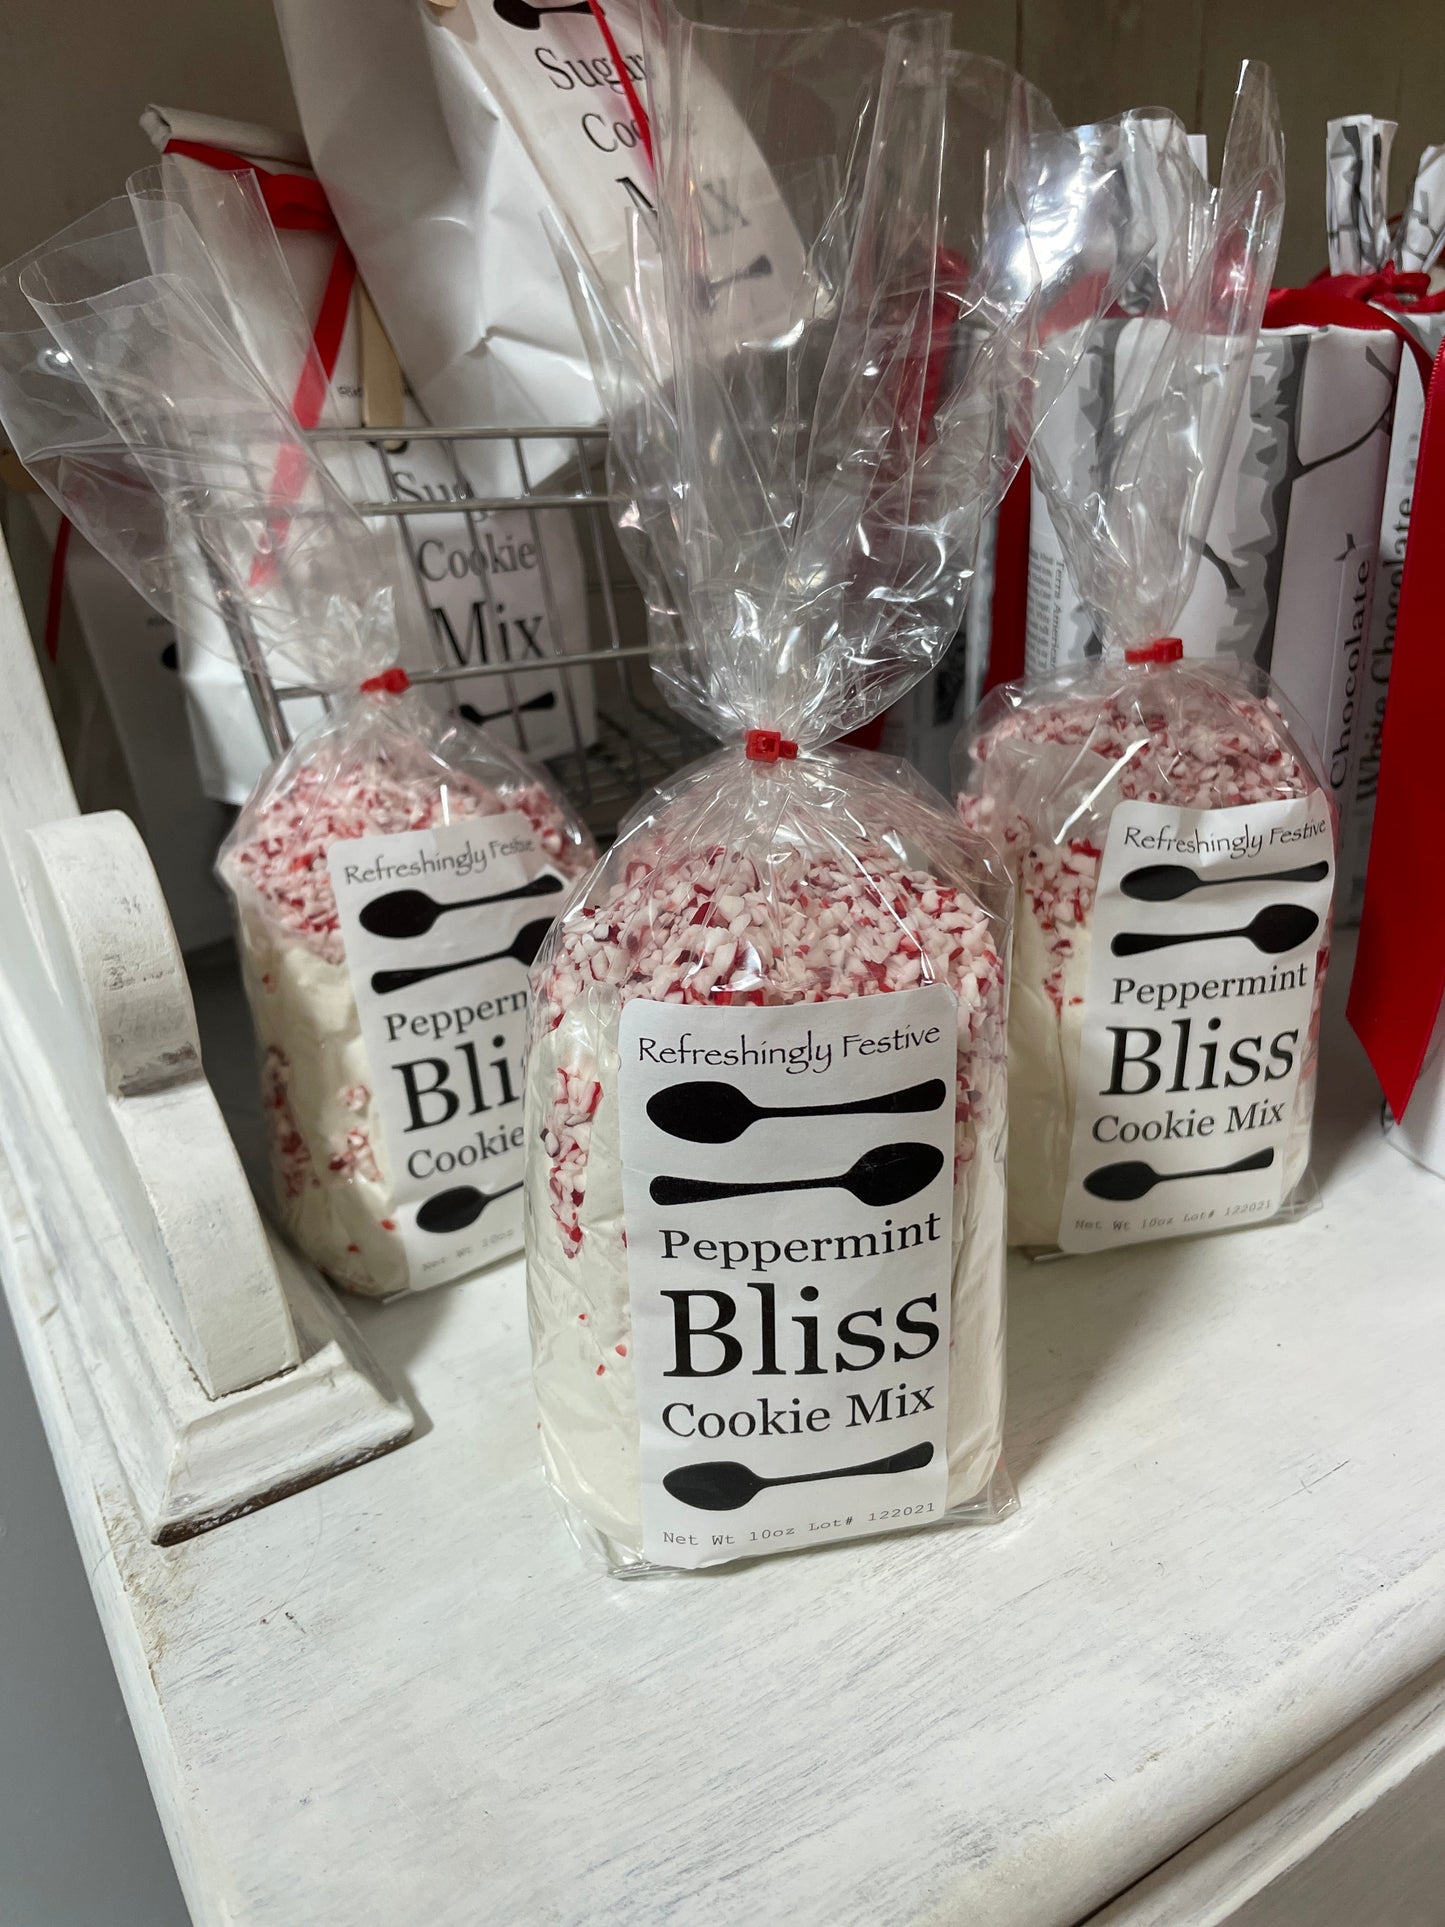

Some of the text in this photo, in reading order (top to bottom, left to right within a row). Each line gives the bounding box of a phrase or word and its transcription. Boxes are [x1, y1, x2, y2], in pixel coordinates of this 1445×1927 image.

[417, 533, 539, 582] Cookie
[430, 600, 545, 667] Mix
[1330, 559, 1369, 789] Chocolate
[344, 841, 487, 885] Refreshingly
[1124, 826, 1264, 859] Refreshingly
[1269, 817, 1327, 844] Festive
[1111, 964, 1308, 1011] Peppermint
[638, 1023, 941, 1074] Refreshingly Festive
[1100, 1017, 1299, 1096] Bliss
[391, 1034, 525, 1134] Bli
[1091, 1100, 1286, 1143] Cookie Mix
[407, 1124, 525, 1180] Cookie
[1074, 1199, 1272, 1231] Net Wt 10oz Lot# 122021
[659, 1212, 942, 1272] Peppermint
[659, 1281, 940, 1378] Bliss
[661, 1382, 936, 1439] Cookie Mix
[663, 1502, 936, 1547] Net Wt 10oz Lot# 122021
